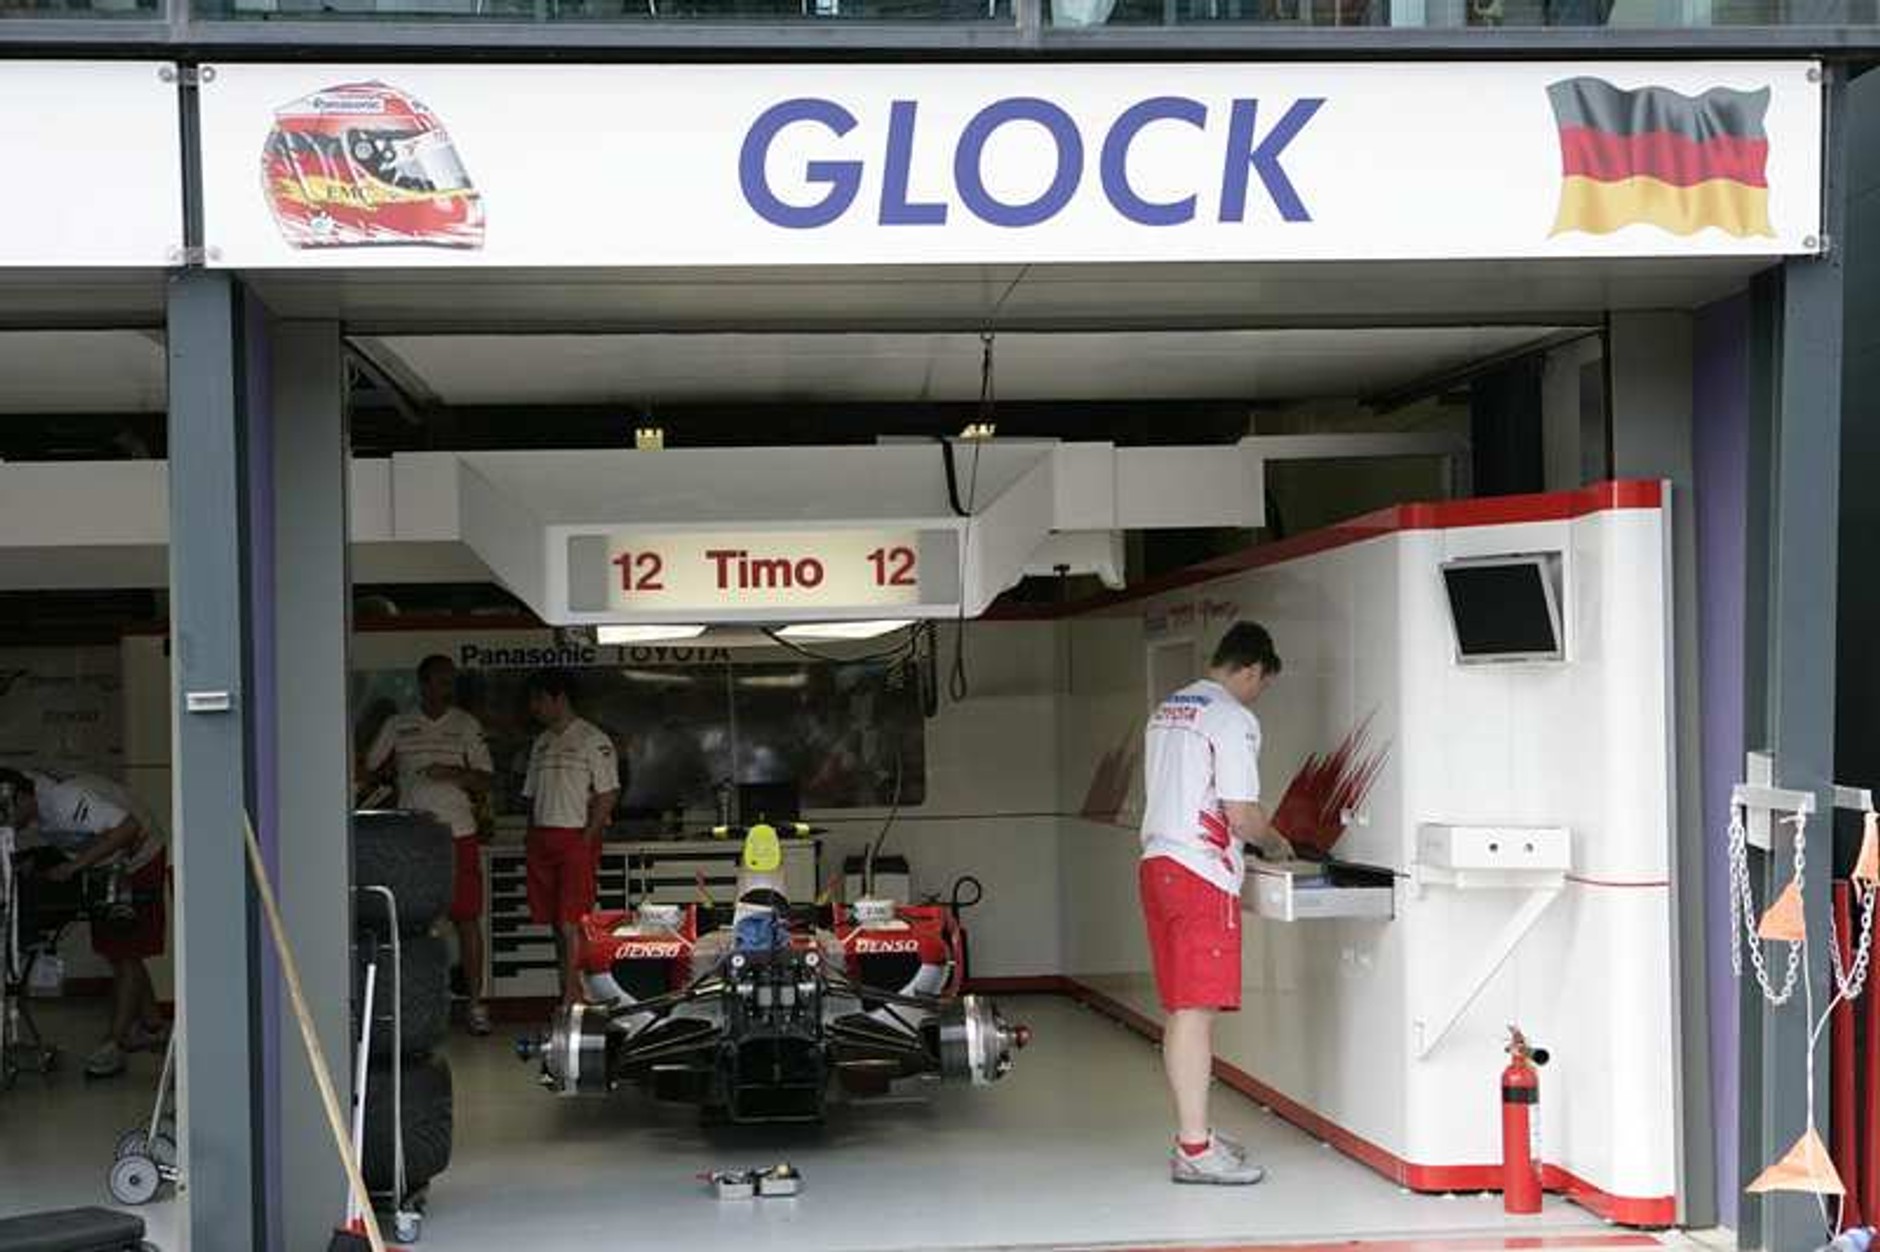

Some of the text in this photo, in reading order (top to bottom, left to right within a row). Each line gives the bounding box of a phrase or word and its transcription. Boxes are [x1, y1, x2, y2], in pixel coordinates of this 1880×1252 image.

[738, 96, 1327, 229] GLOCK
[612, 546, 917, 591] 12 Timo 12
[459, 643, 732, 666] Panasonic TOYOTA
[855, 938, 920, 954] DENSO
